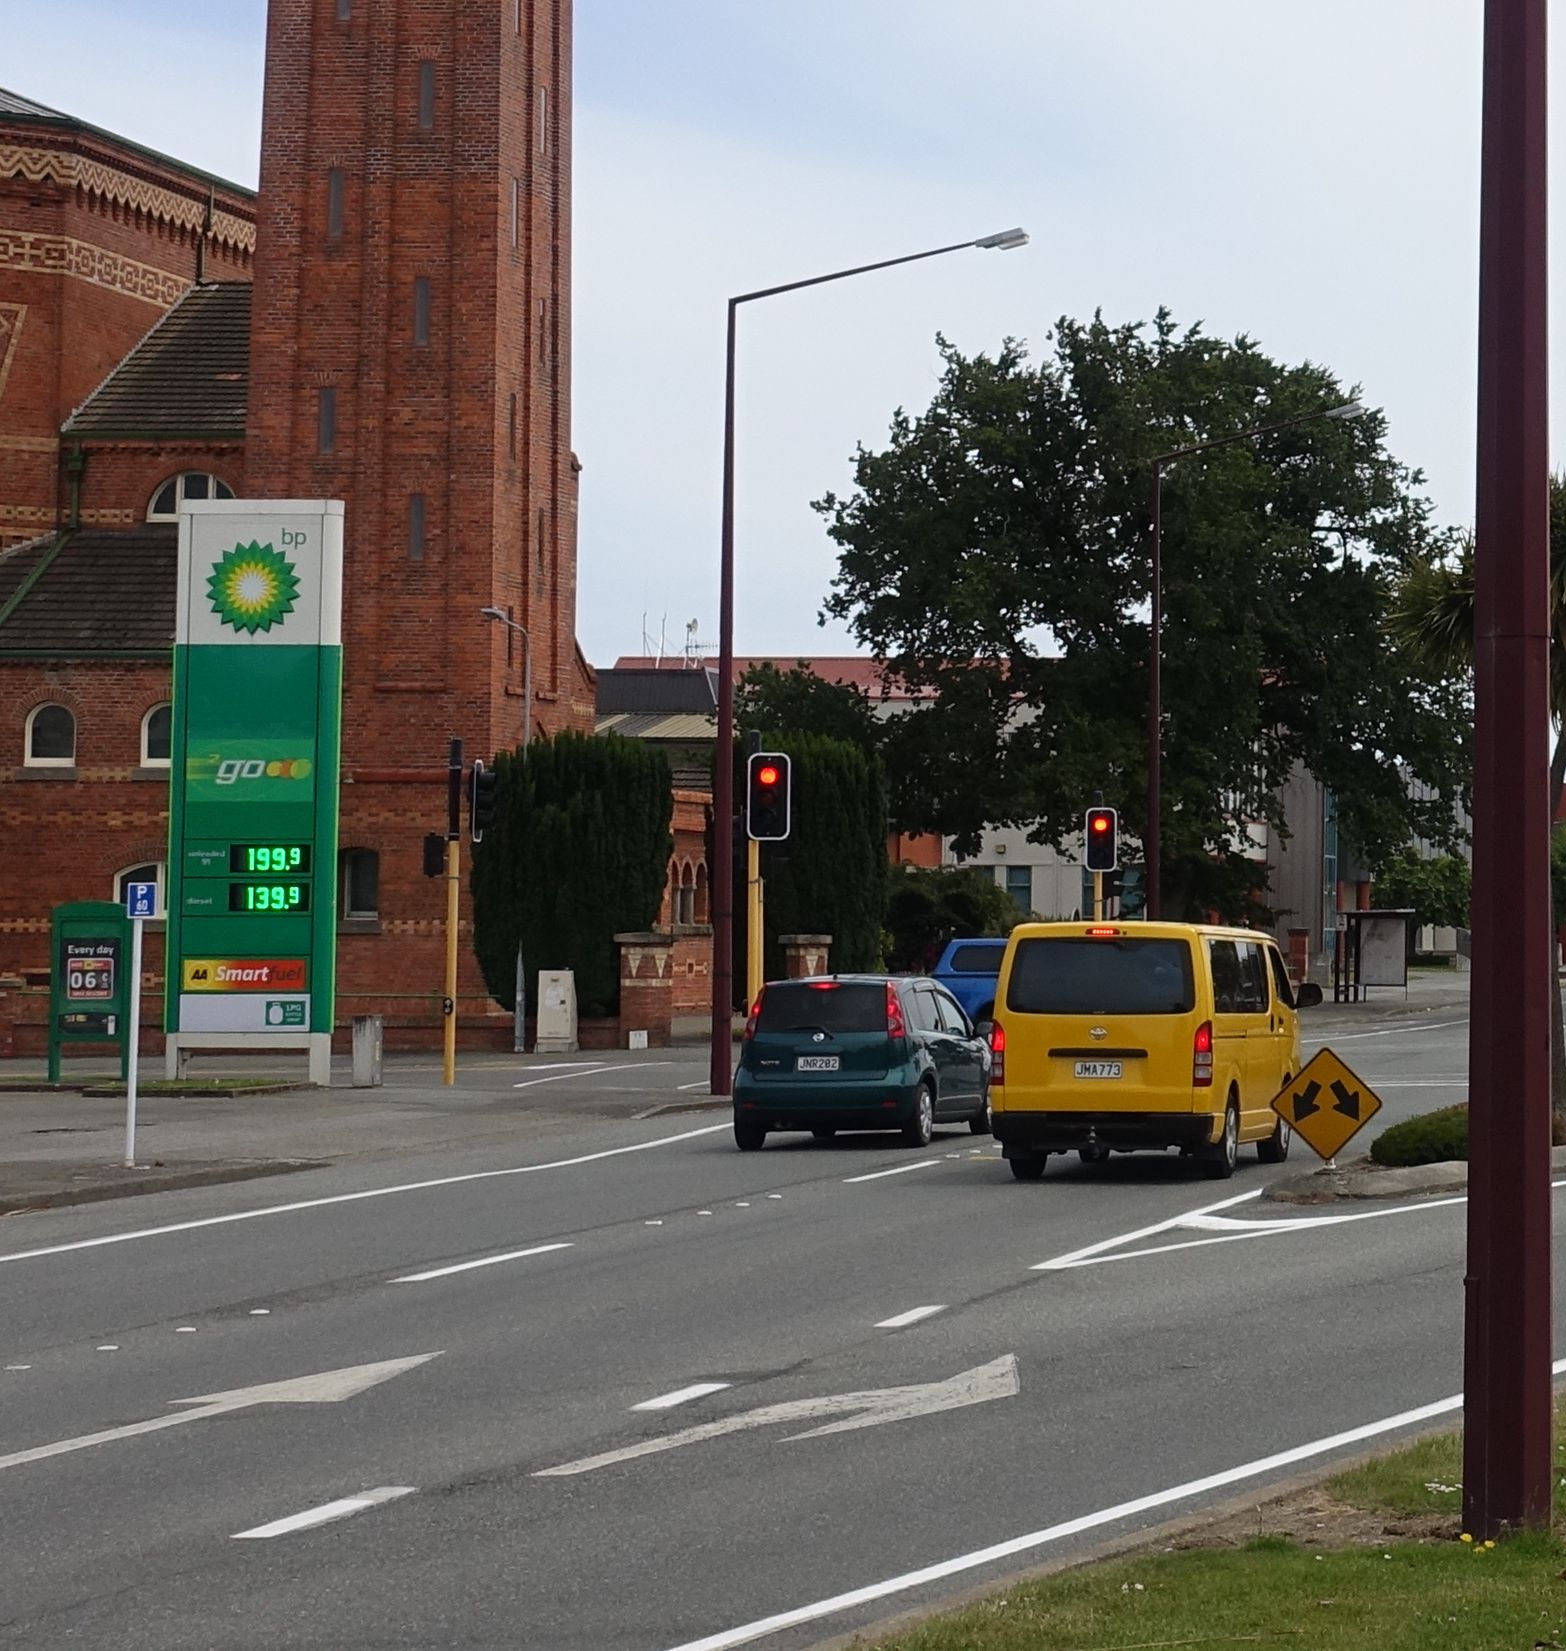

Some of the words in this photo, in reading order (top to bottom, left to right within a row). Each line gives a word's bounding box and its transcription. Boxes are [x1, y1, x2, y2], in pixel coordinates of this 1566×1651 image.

[281, 527, 307, 550] bp
[215, 759, 266, 785] go
[248, 847, 301, 871] 199.9
[137, 886, 147, 898] P
[247, 886, 300, 909] 139.9
[136, 900, 148, 911] 60
[67, 945, 94, 956] Every
[96, 945, 115, 957] day
[191, 969, 208, 980] AA
[1076, 1063, 1121, 1076] JMA773
